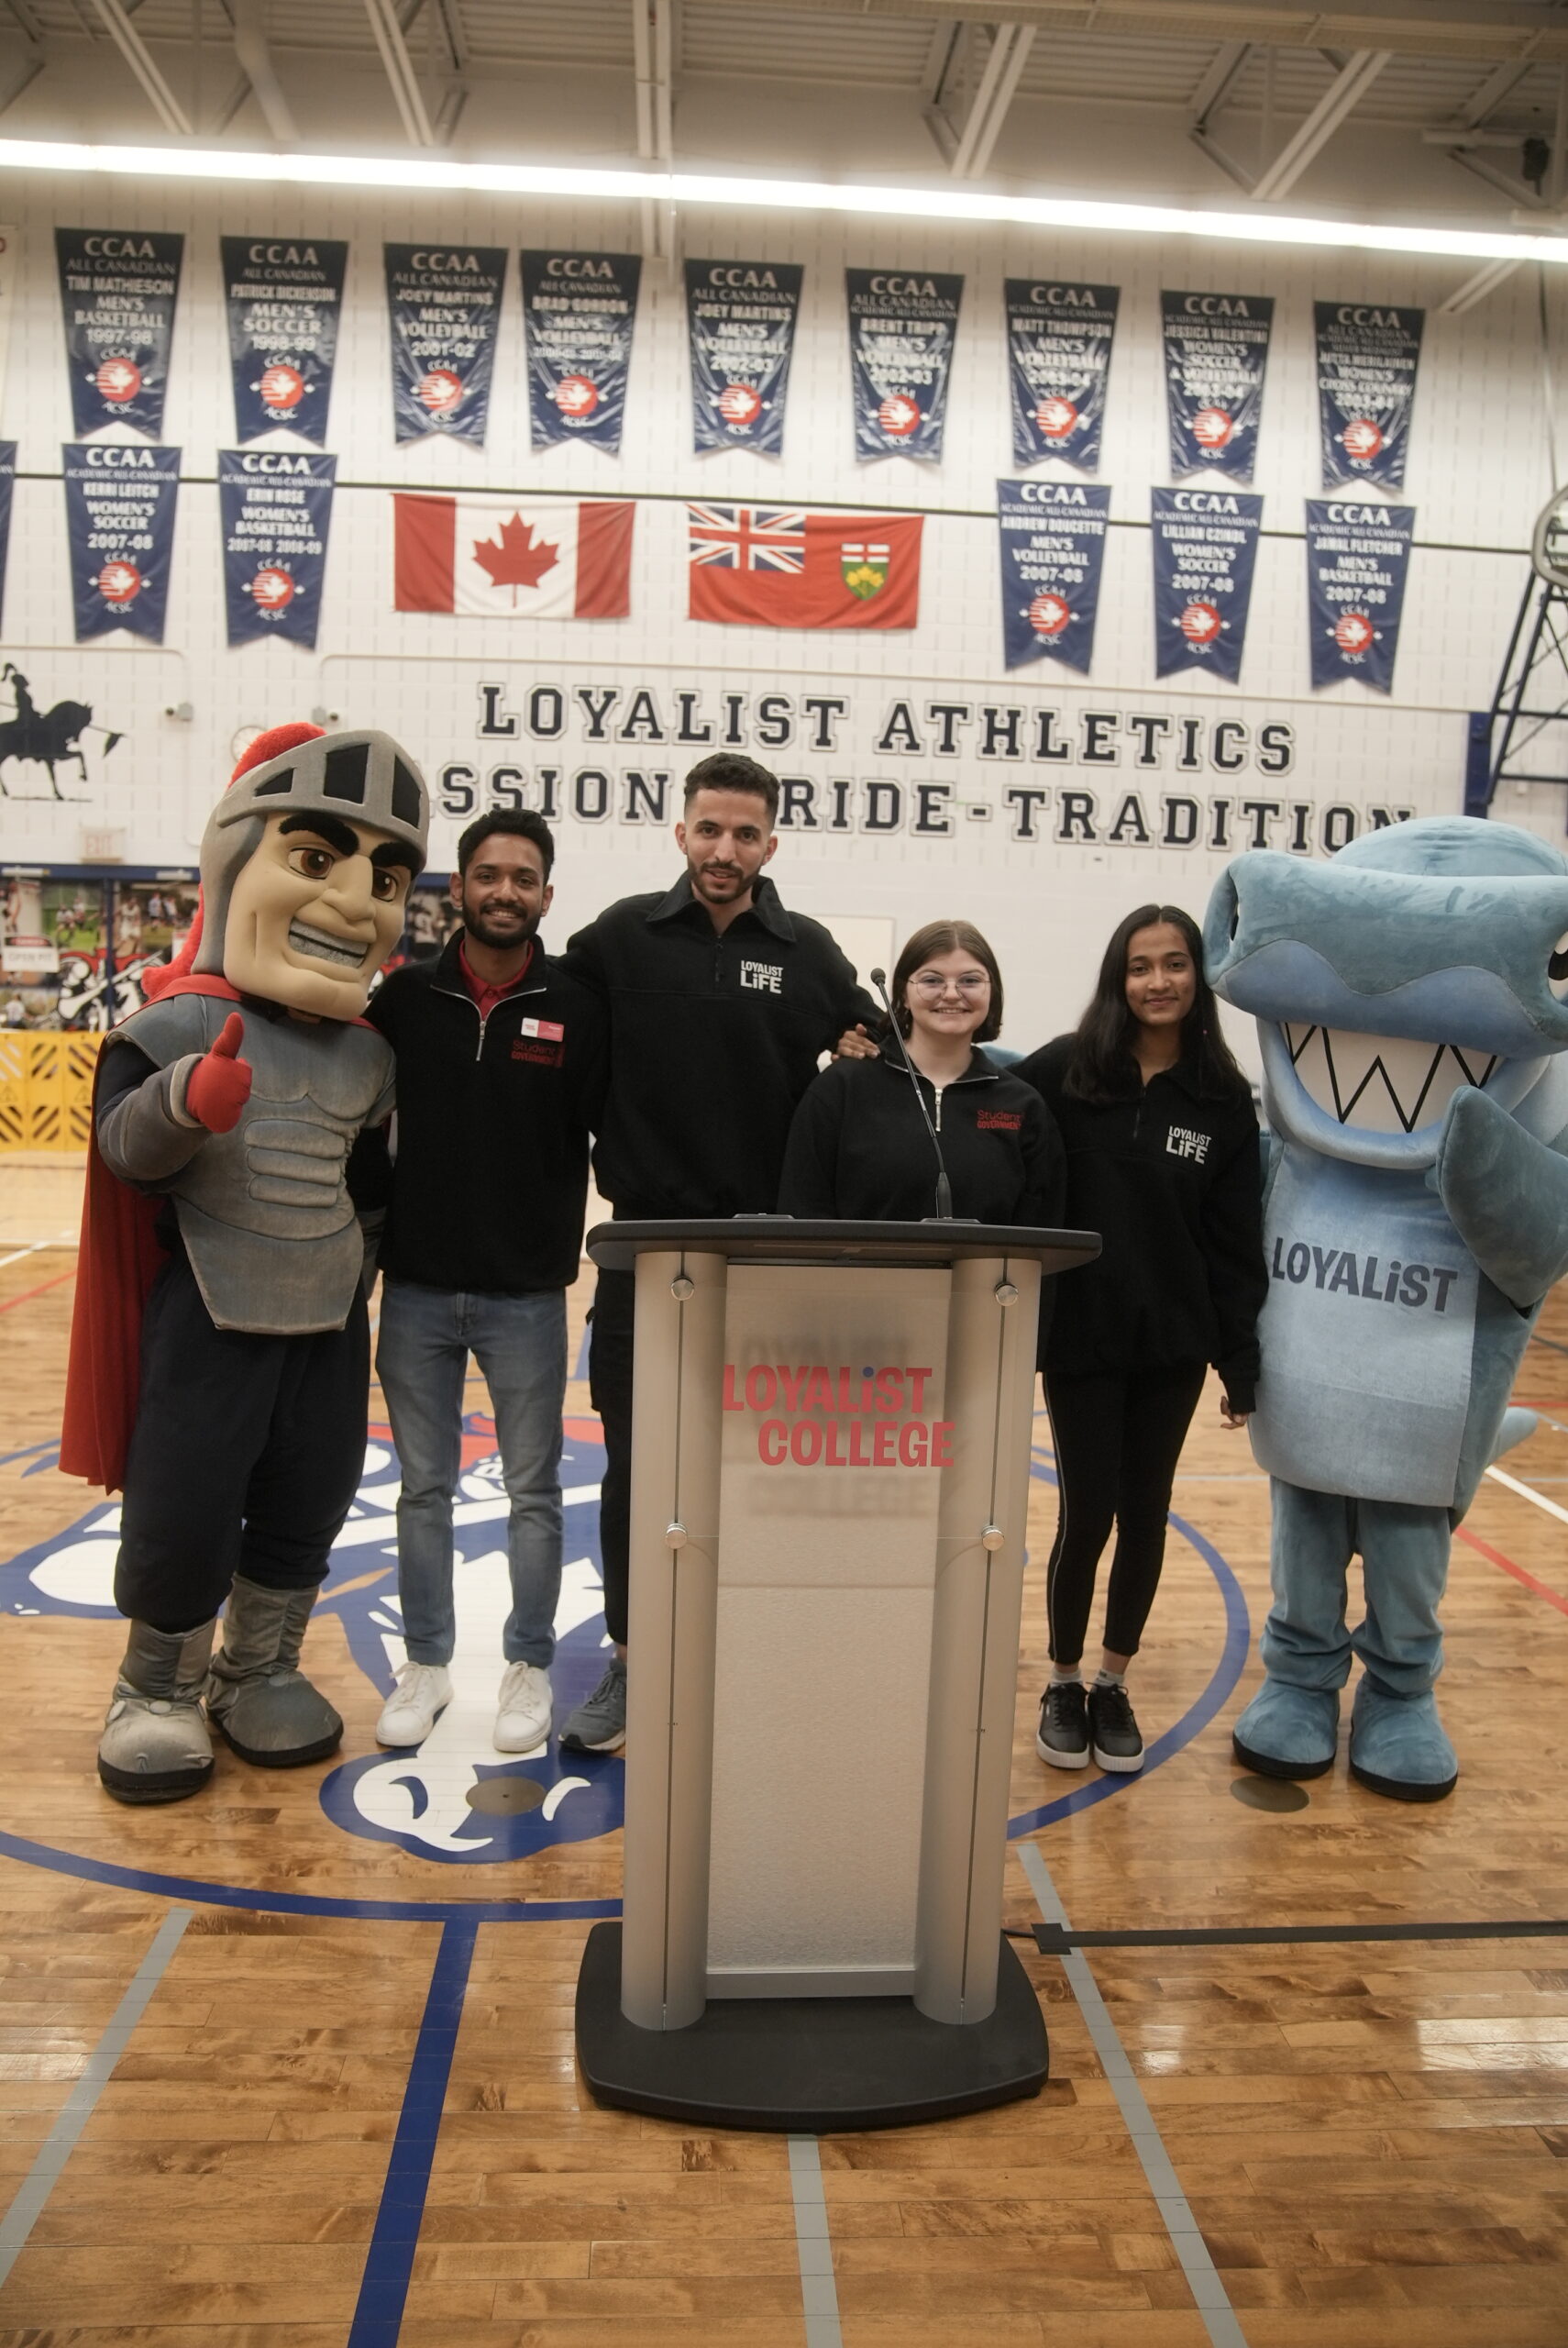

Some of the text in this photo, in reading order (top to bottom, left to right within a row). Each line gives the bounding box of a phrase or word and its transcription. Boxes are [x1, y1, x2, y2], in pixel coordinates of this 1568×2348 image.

[84, 237, 155, 257] CCAA
[248, 245, 318, 265] CCAA
[66, 258, 176, 274] ALL CANADIAN
[412, 252, 480, 271] CCAA
[547, 259, 613, 278] CCAA
[243, 267, 326, 281] ALL CANADIAN
[393, 271, 498, 287] ALL CANADIAN
[709, 268, 777, 288] CCAA
[66, 275, 174, 294] TIM MATHIESON
[871, 277, 936, 297] CCAA
[95, 295, 145, 311] MEN'S
[396, 289, 493, 305] JOEY MARTINS
[692, 288, 796, 304] ALL CANADIAN
[852, 294, 955, 309] ALL CANADIAN
[1030, 286, 1096, 307] CCAA
[251, 303, 315, 317] MEN'S
[695, 304, 791, 321] JOEY MARTINS
[1185, 296, 1249, 316] CCAA
[74, 310, 165, 328] BASKETBALL
[419, 308, 468, 322] MEN'S
[554, 316, 602, 330] MEN'S
[1337, 306, 1400, 327] CCAA
[243, 318, 321, 334] SOCCER
[400, 322, 489, 338] VOLLEYBALL
[717, 323, 767, 338] MEN'S
[860, 318, 947, 335] BRENT TRIPP
[1012, 318, 1111, 338] MATT THOMPSON
[1164, 325, 1209, 340] JESSICA
[86, 328, 153, 345] 1997-98
[251, 335, 315, 350] 1998-99
[534, 330, 622, 345] VOLLEYBALL
[877, 336, 925, 350] MEN'S
[412, 342, 475, 358] 2001-02
[698, 337, 787, 353] VOLLEYBALL
[1036, 338, 1085, 352] MEN'S
[1183, 340, 1248, 356] WOMEN'S
[711, 355, 774, 372] 2002-03
[856, 349, 944, 368] VOLLEYBALL
[1015, 350, 1107, 371] VOLLEYBALL
[1191, 355, 1242, 370] SOCCER
[870, 367, 932, 384] 2002-03
[1028, 369, 1090, 387] 2003-04
[1184, 369, 1258, 383] VOLLEYBALL
[1338, 366, 1394, 382] WOMEN'S
[1183, 382, 1243, 399] 2003-04
[1320, 378, 1412, 395] CROSS COUNTRY
[86, 448, 155, 468] CCAA
[242, 454, 311, 475] CCAA
[118, 482, 160, 498] LEITCH
[275, 490, 305, 504] ROSE
[1021, 483, 1087, 504] CCAA
[86, 502, 155, 516] WOMEN'S
[1174, 492, 1239, 514] CCAA
[241, 506, 310, 522] WOMEN'S
[1328, 504, 1390, 526] CCAA
[94, 515, 148, 530] SOCCER
[235, 521, 315, 537] BASKETBALL
[1001, 516, 1104, 535] ANDREW DOUCETTE
[1162, 525, 1204, 540] LILLIAN
[87, 533, 153, 549] 2007-08
[1031, 536, 1074, 550] MEN'S
[1314, 537, 1402, 555] JAMAL FLETCHER
[1012, 548, 1089, 565] VOLLEYBALL
[1172, 543, 1236, 559] WOMEN'S
[1178, 558, 1229, 573] SOCCER
[1338, 556, 1378, 571] MEN'S
[1020, 566, 1083, 582] 2007-08
[1320, 569, 1393, 586] BASKETBALL
[1172, 574, 1234, 593] 2007-08
[1326, 586, 1386, 604] 2007-08
[479, 683, 1295, 775] LOYALIST ATHLETICS
[757, 1418, 955, 1468] COLLEGE
